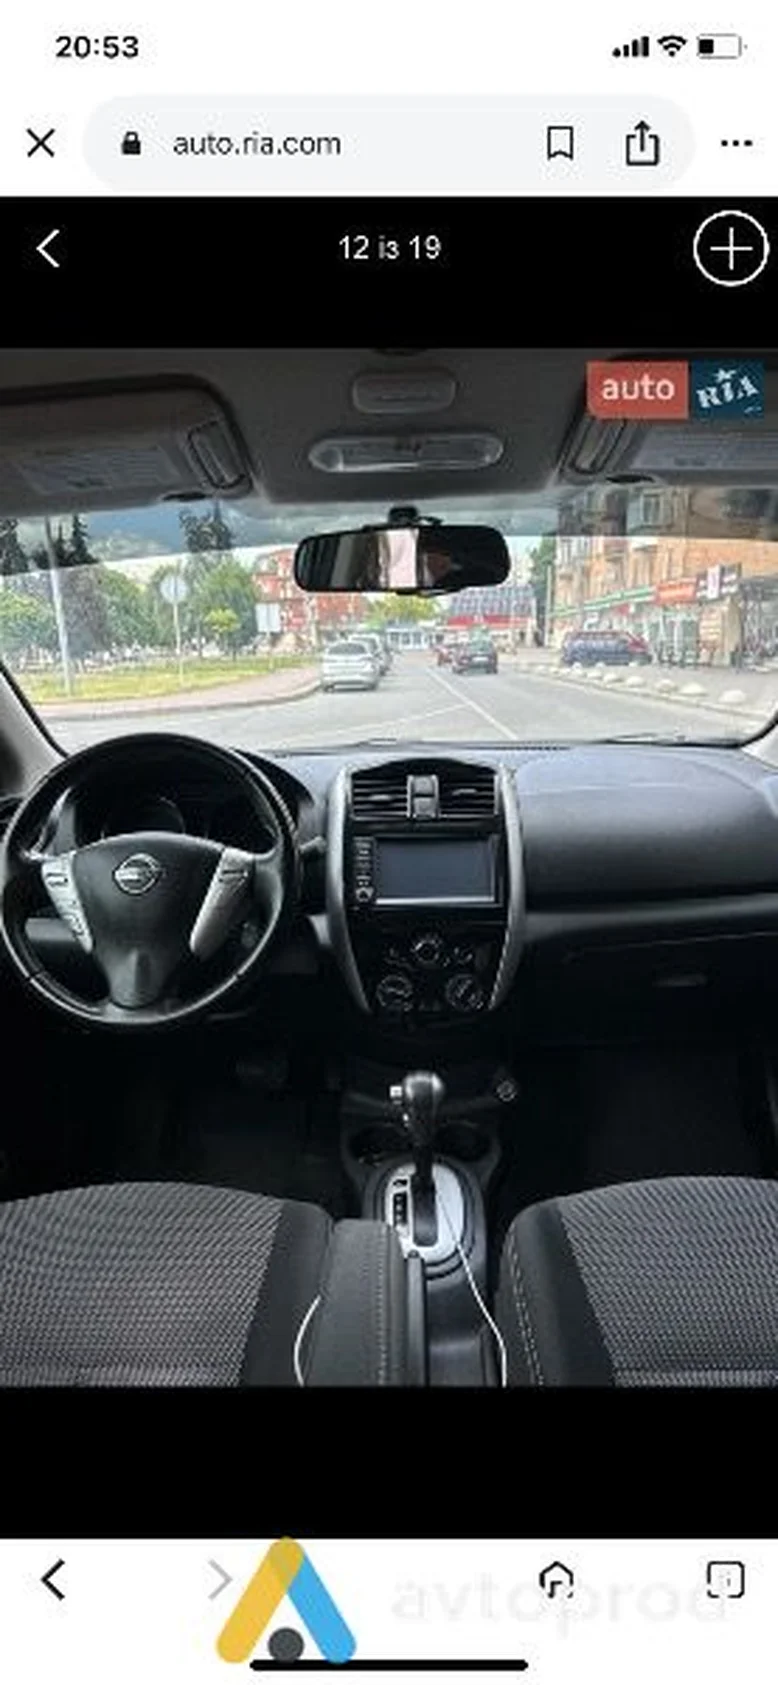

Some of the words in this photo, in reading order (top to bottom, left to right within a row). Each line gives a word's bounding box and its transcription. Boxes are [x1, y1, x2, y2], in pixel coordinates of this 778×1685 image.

[55, 35, 139, 60] 20:53
[173, 131, 341, 156] auto.ria.com
[339, 235, 369, 260] 12
[409, 235, 441, 260] 19
